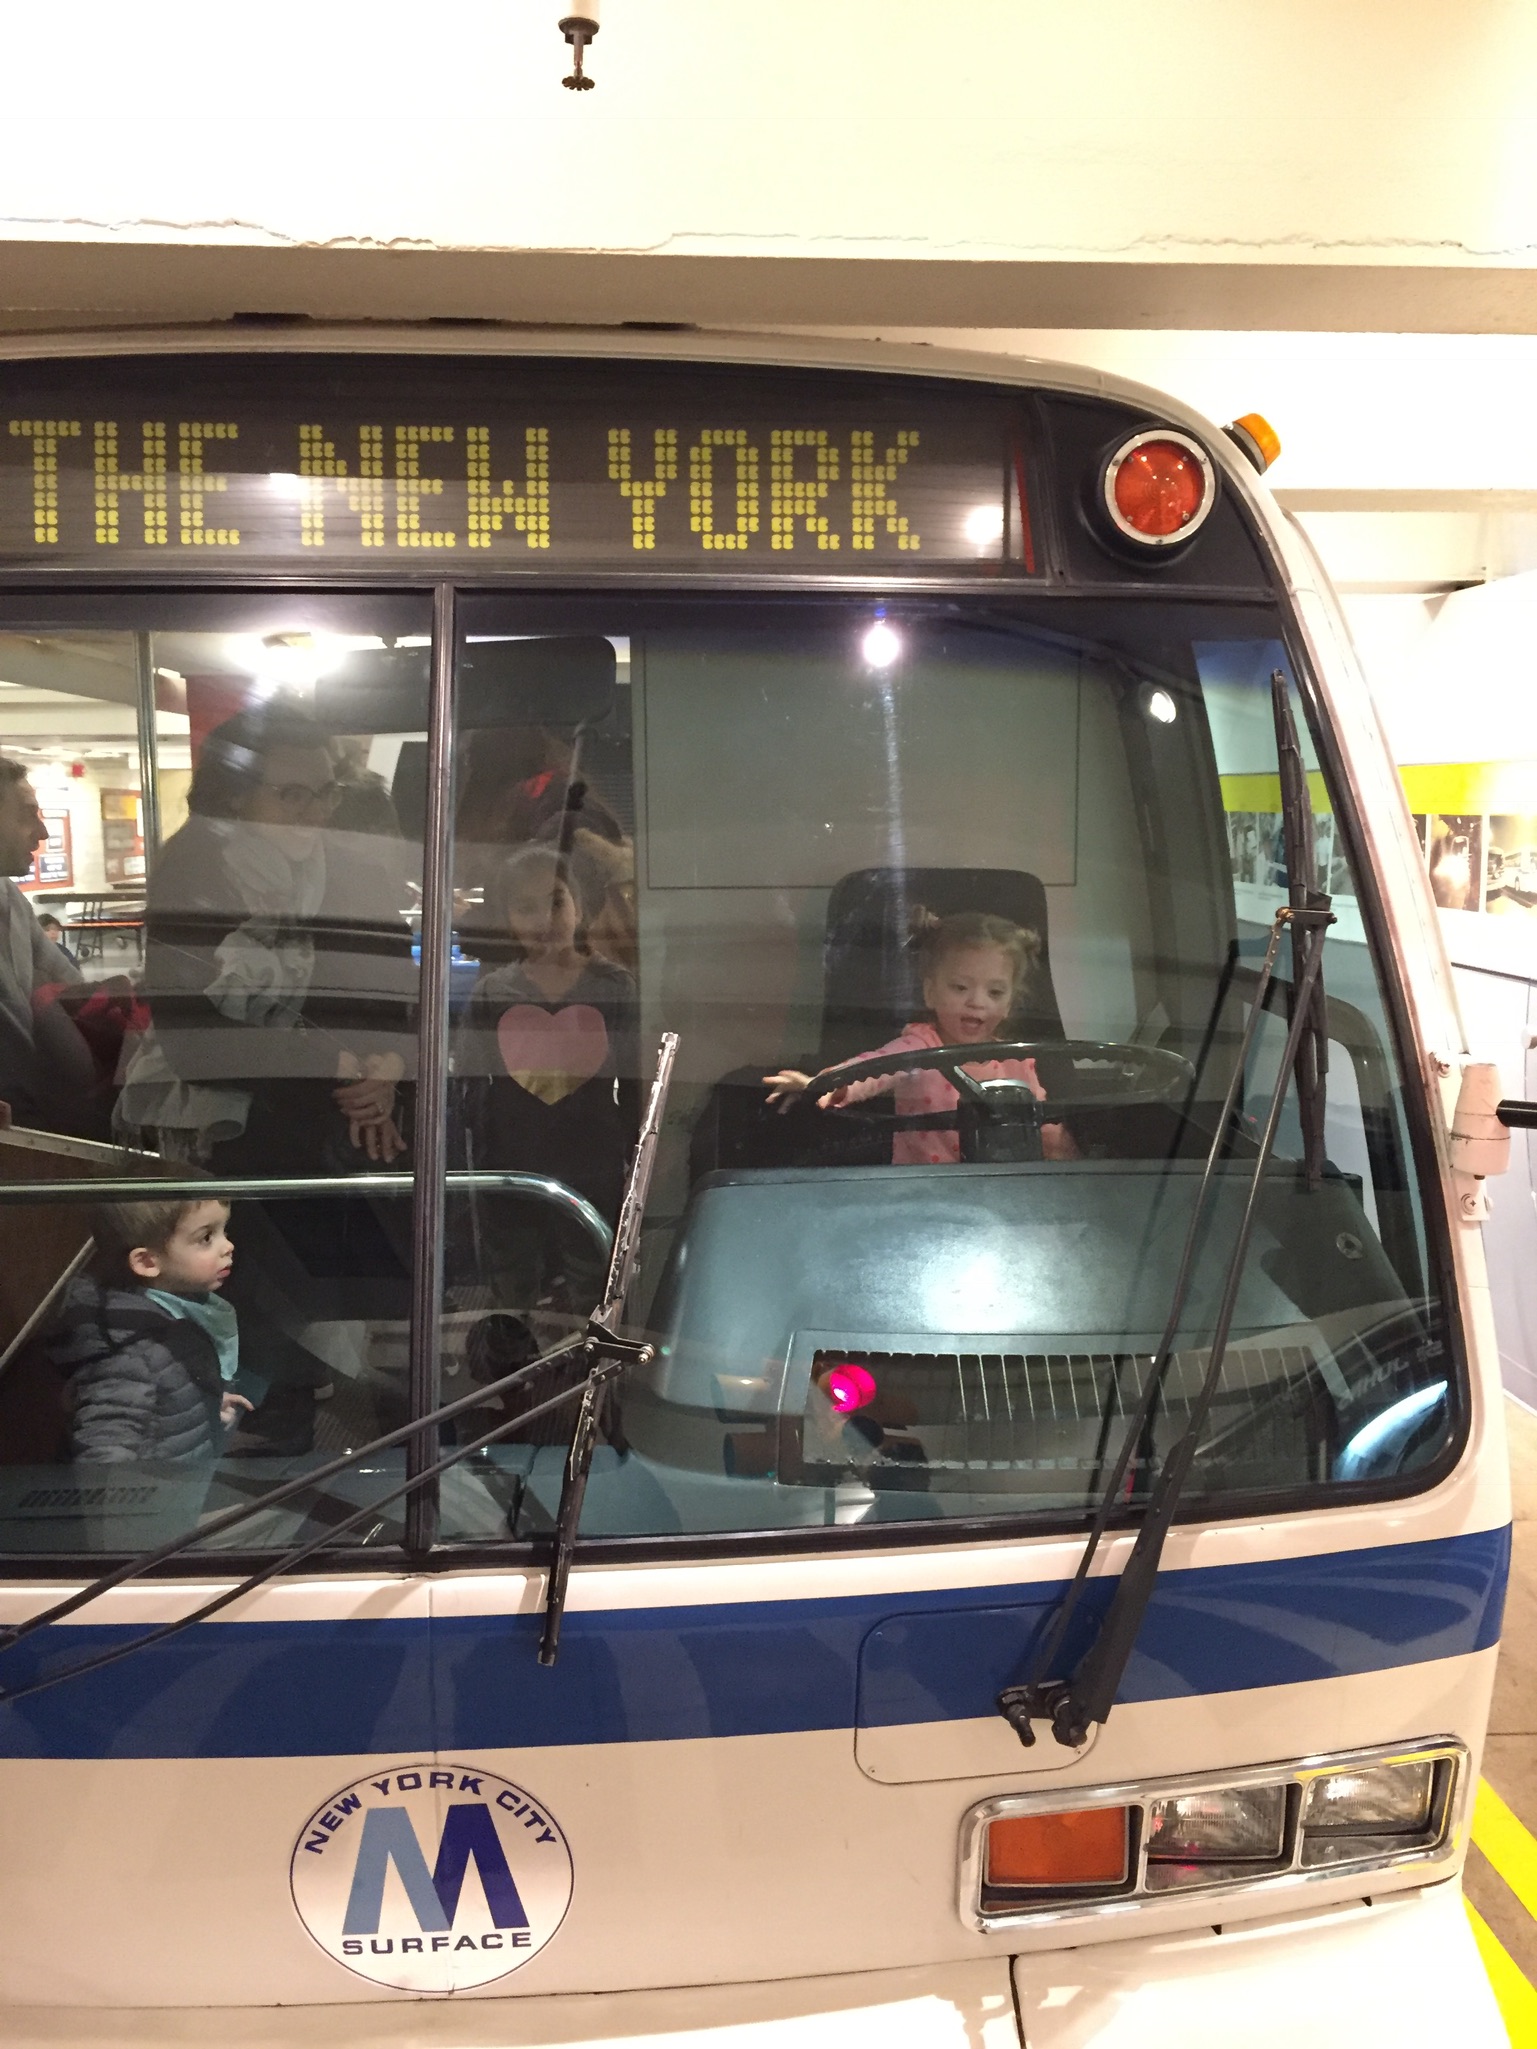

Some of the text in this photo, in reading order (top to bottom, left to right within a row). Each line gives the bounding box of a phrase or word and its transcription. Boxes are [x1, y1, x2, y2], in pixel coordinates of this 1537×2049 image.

[9, 420, 921, 551] THE NEW YORK
[304, 1771, 557, 1854] NEW YORK CITY
[342, 1931, 532, 1956] SURFACE
